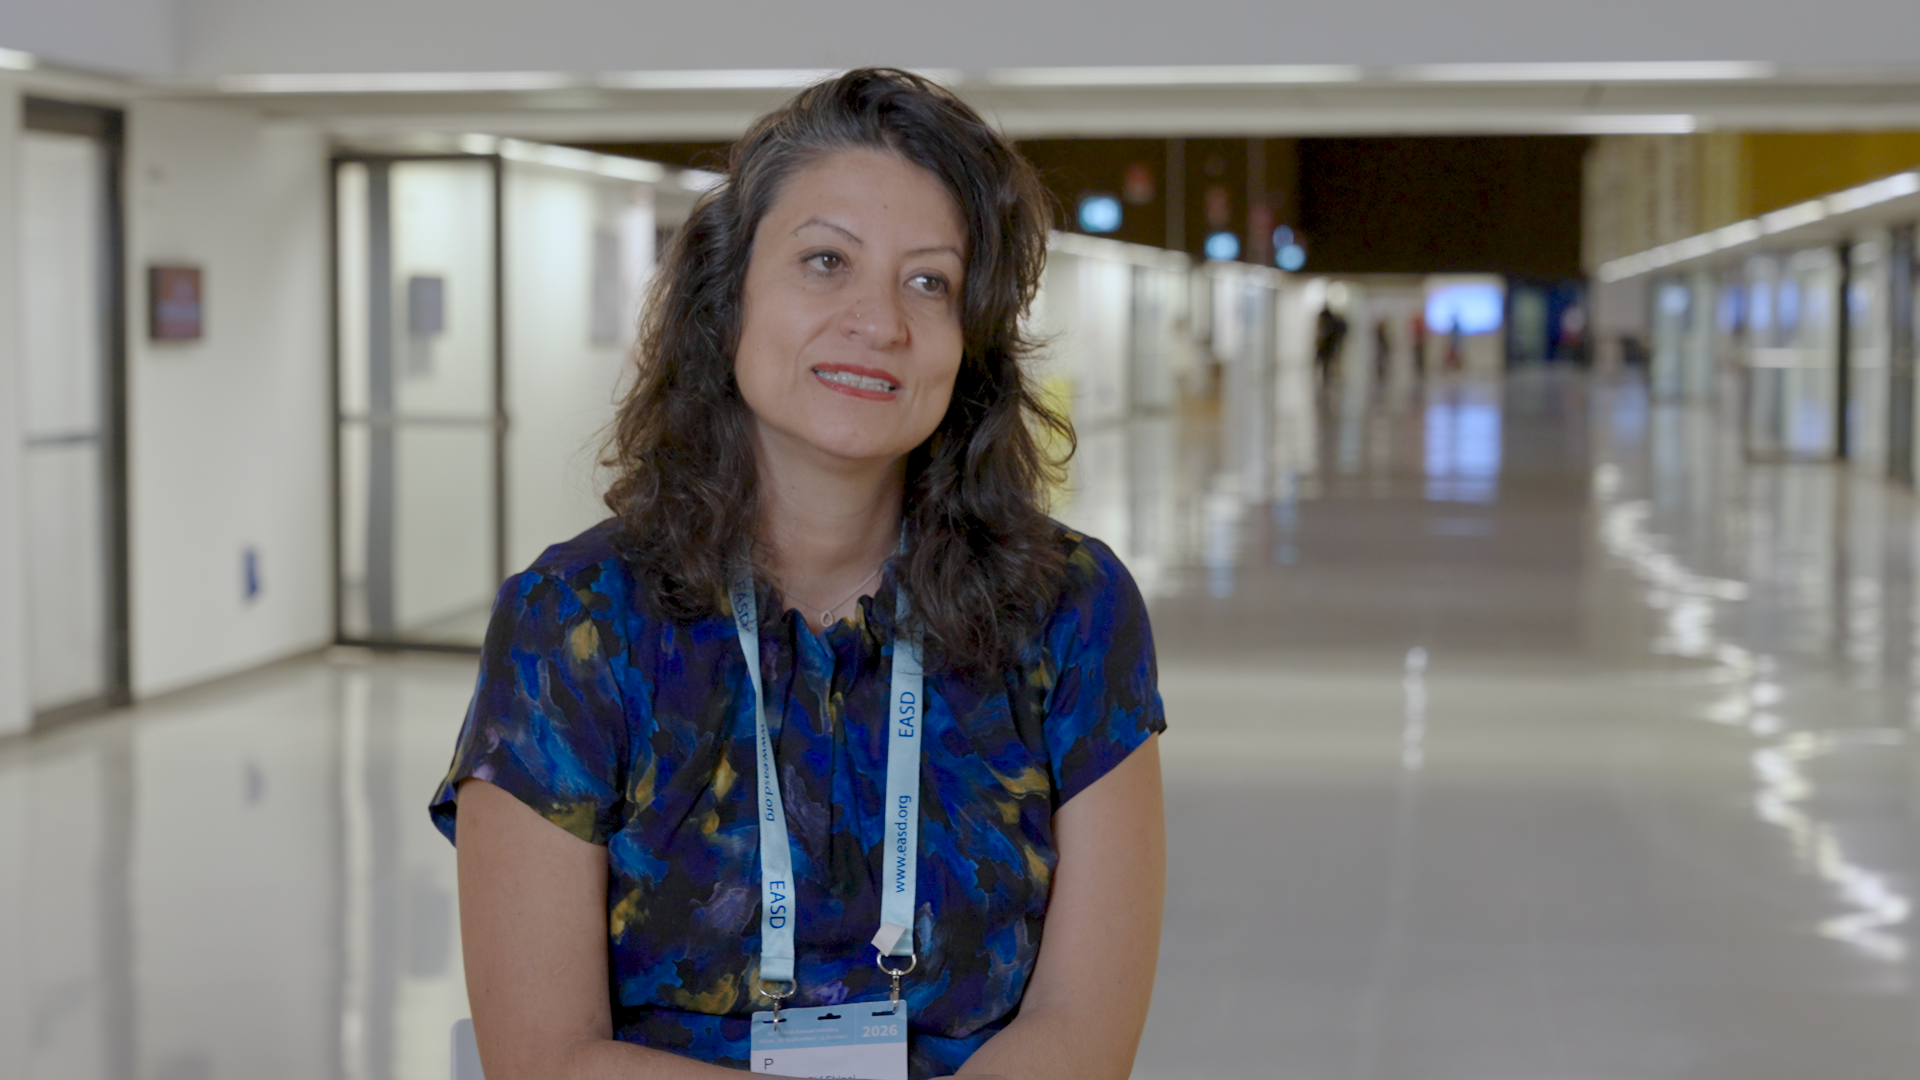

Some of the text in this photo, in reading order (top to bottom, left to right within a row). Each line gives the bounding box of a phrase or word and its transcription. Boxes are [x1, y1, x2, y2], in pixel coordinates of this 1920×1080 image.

[734, 580, 750, 627] EASD
[898, 691, 916, 738] EASD
[760, 724, 775, 822] www.easd.org
[894, 795, 912, 893] www.easd.org
[769, 880, 786, 929] EASD
[862, 1024, 898, 1038] 2026
[764, 1058, 774, 1070] P
